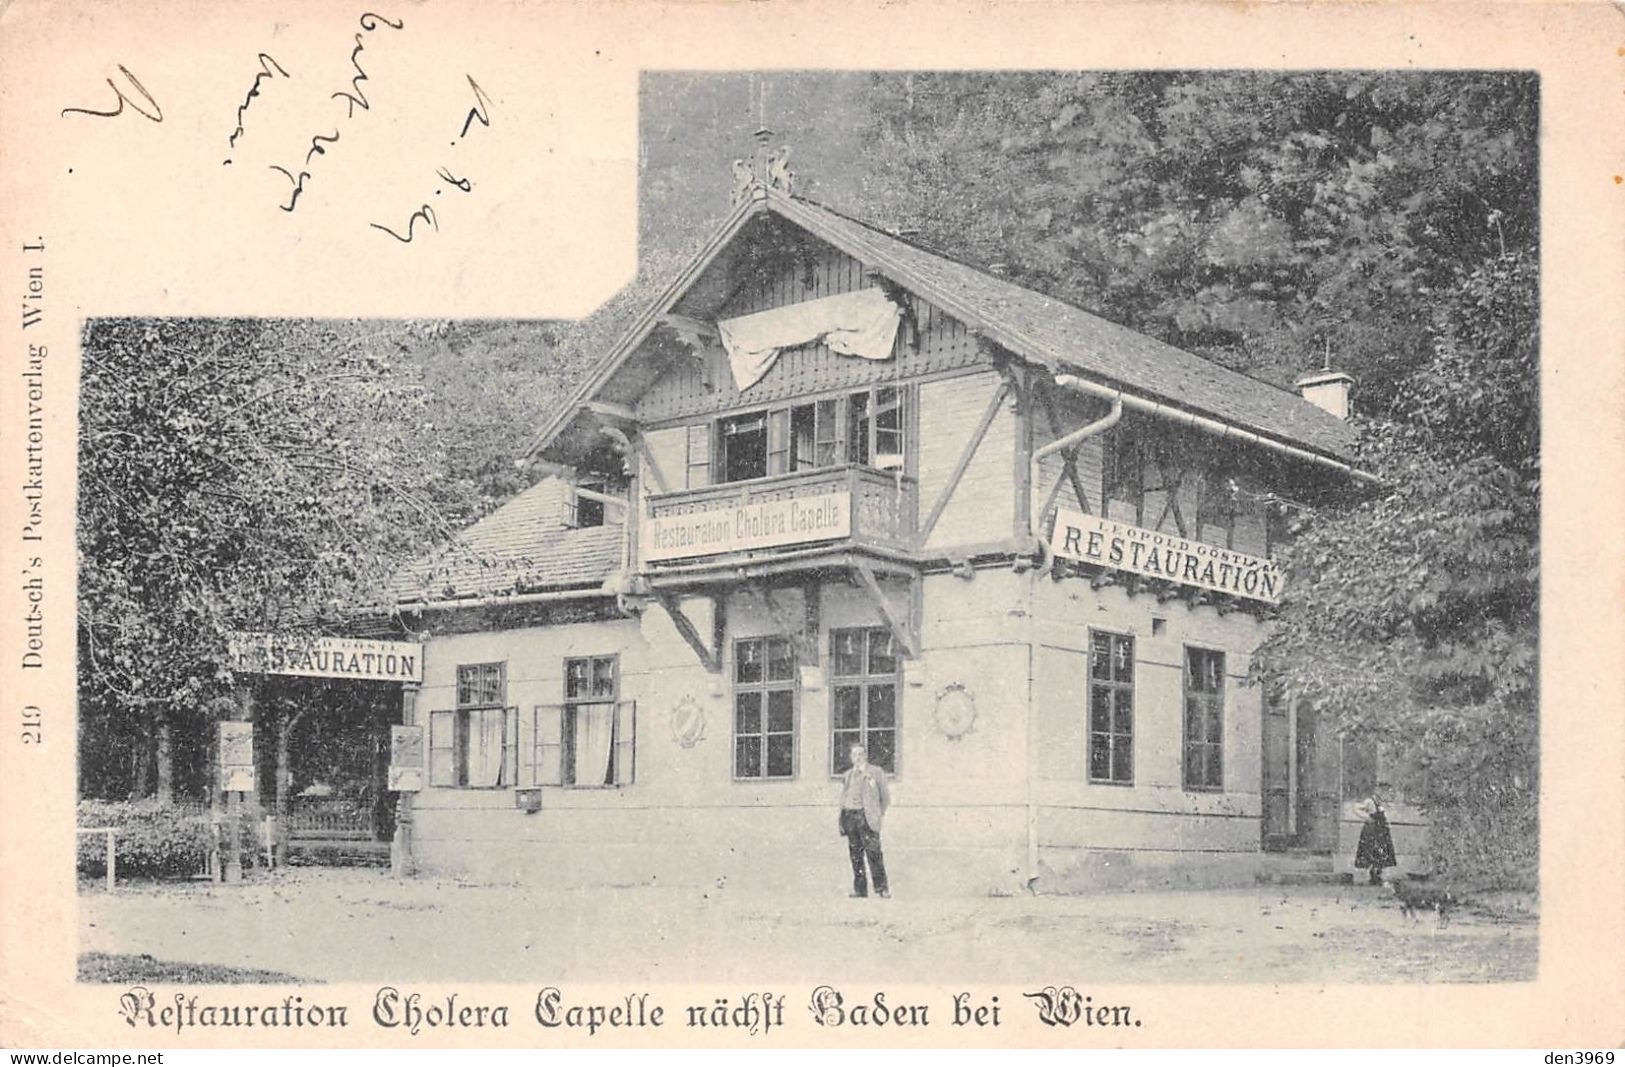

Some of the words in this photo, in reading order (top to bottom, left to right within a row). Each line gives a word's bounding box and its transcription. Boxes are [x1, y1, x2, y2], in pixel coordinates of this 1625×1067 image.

[22, 267, 43, 330] Wien
[22, 344, 48, 541] Postkartenverlag
[654, 520, 731, 549] Restauration
[737, 508, 785, 540] Cholera
[791, 498, 839, 533] Capelle
[1064, 525, 1278, 598] RESTAURATION
[22, 557, 43, 669] Deutsch's
[22, 706, 41, 744] 219
[373, 986, 509, 1036] Cholera
[534, 987, 664, 1036] Capelle
[807, 985, 930, 1027] Baden
[951, 991, 1001, 1027] bei
[1022, 985, 1142, 1028] Wien.
